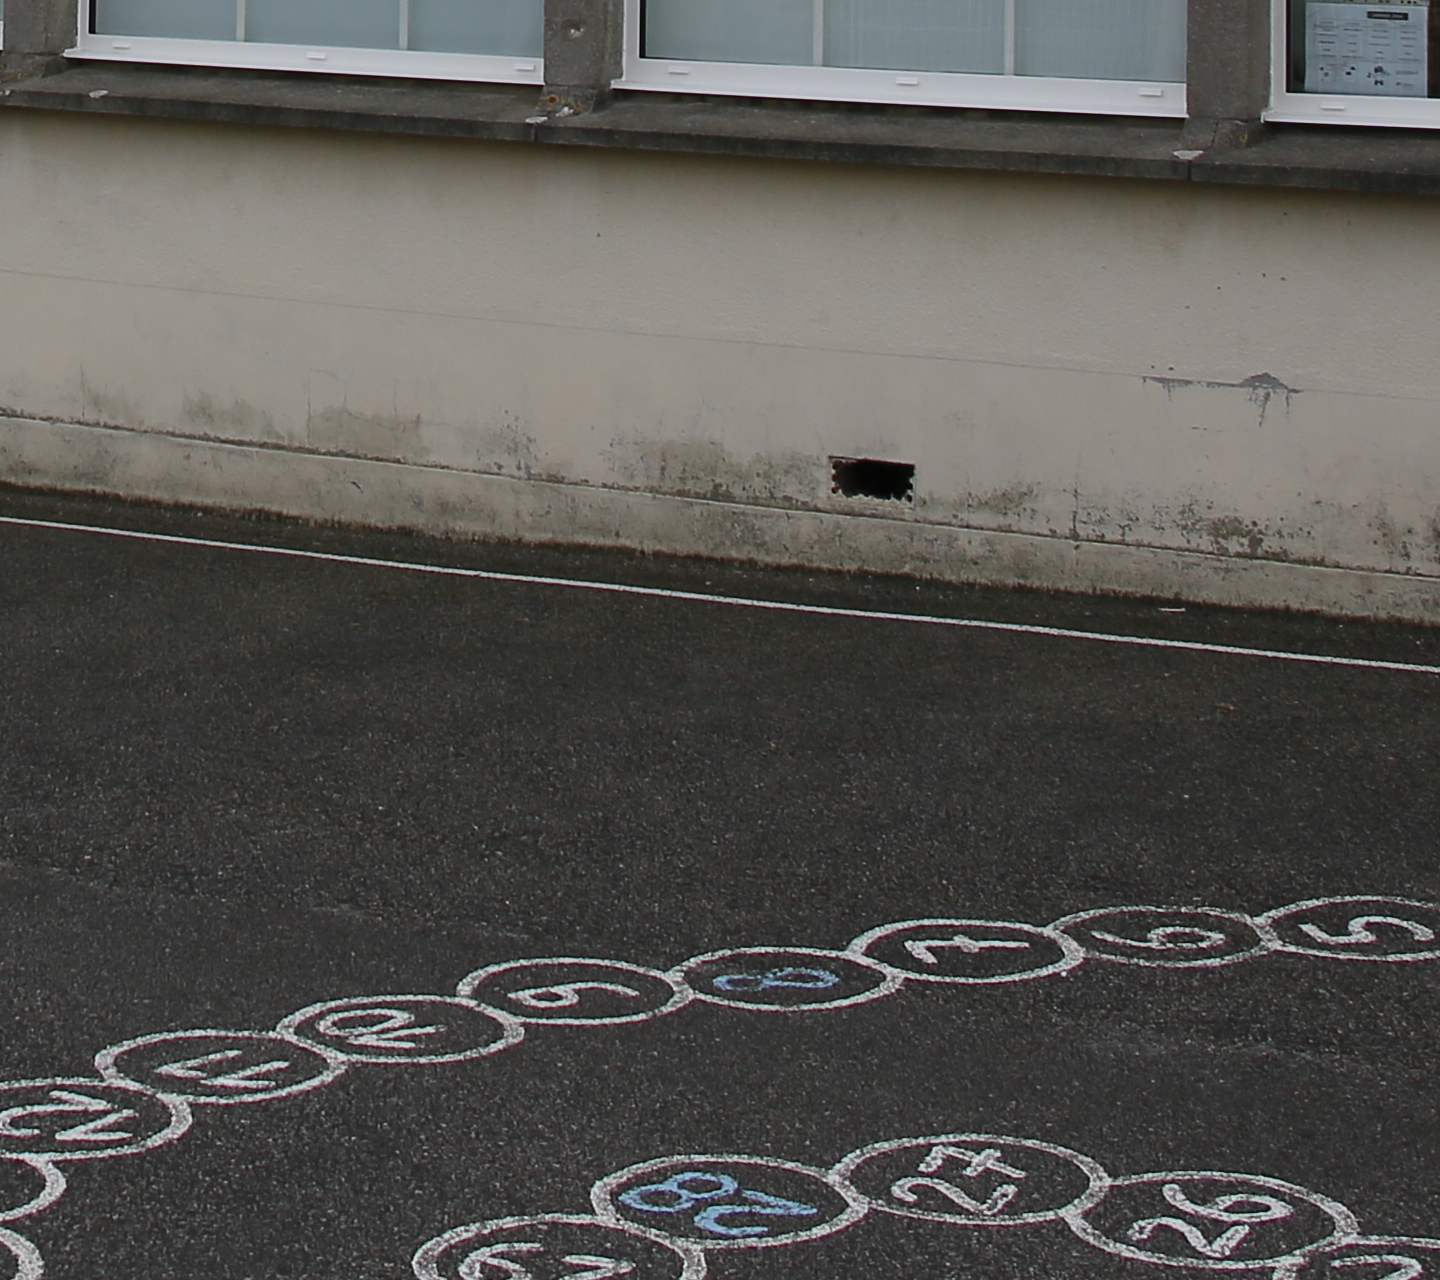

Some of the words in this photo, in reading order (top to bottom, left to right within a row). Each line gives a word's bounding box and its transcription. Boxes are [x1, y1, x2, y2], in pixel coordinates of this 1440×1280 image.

[1091, 925, 1226, 949] 6
[1300, 915, 1433, 944] 5
[507, 981, 639, 1008] 9
[712, 966, 840, 992] 8
[318, 1007, 448, 1049] 10
[153, 1049, 290, 1088] 11
[890, 1145, 1027, 1217] 27
[618, 1171, 818, 1238] 28
[1126, 1183, 1293, 1258] 26
